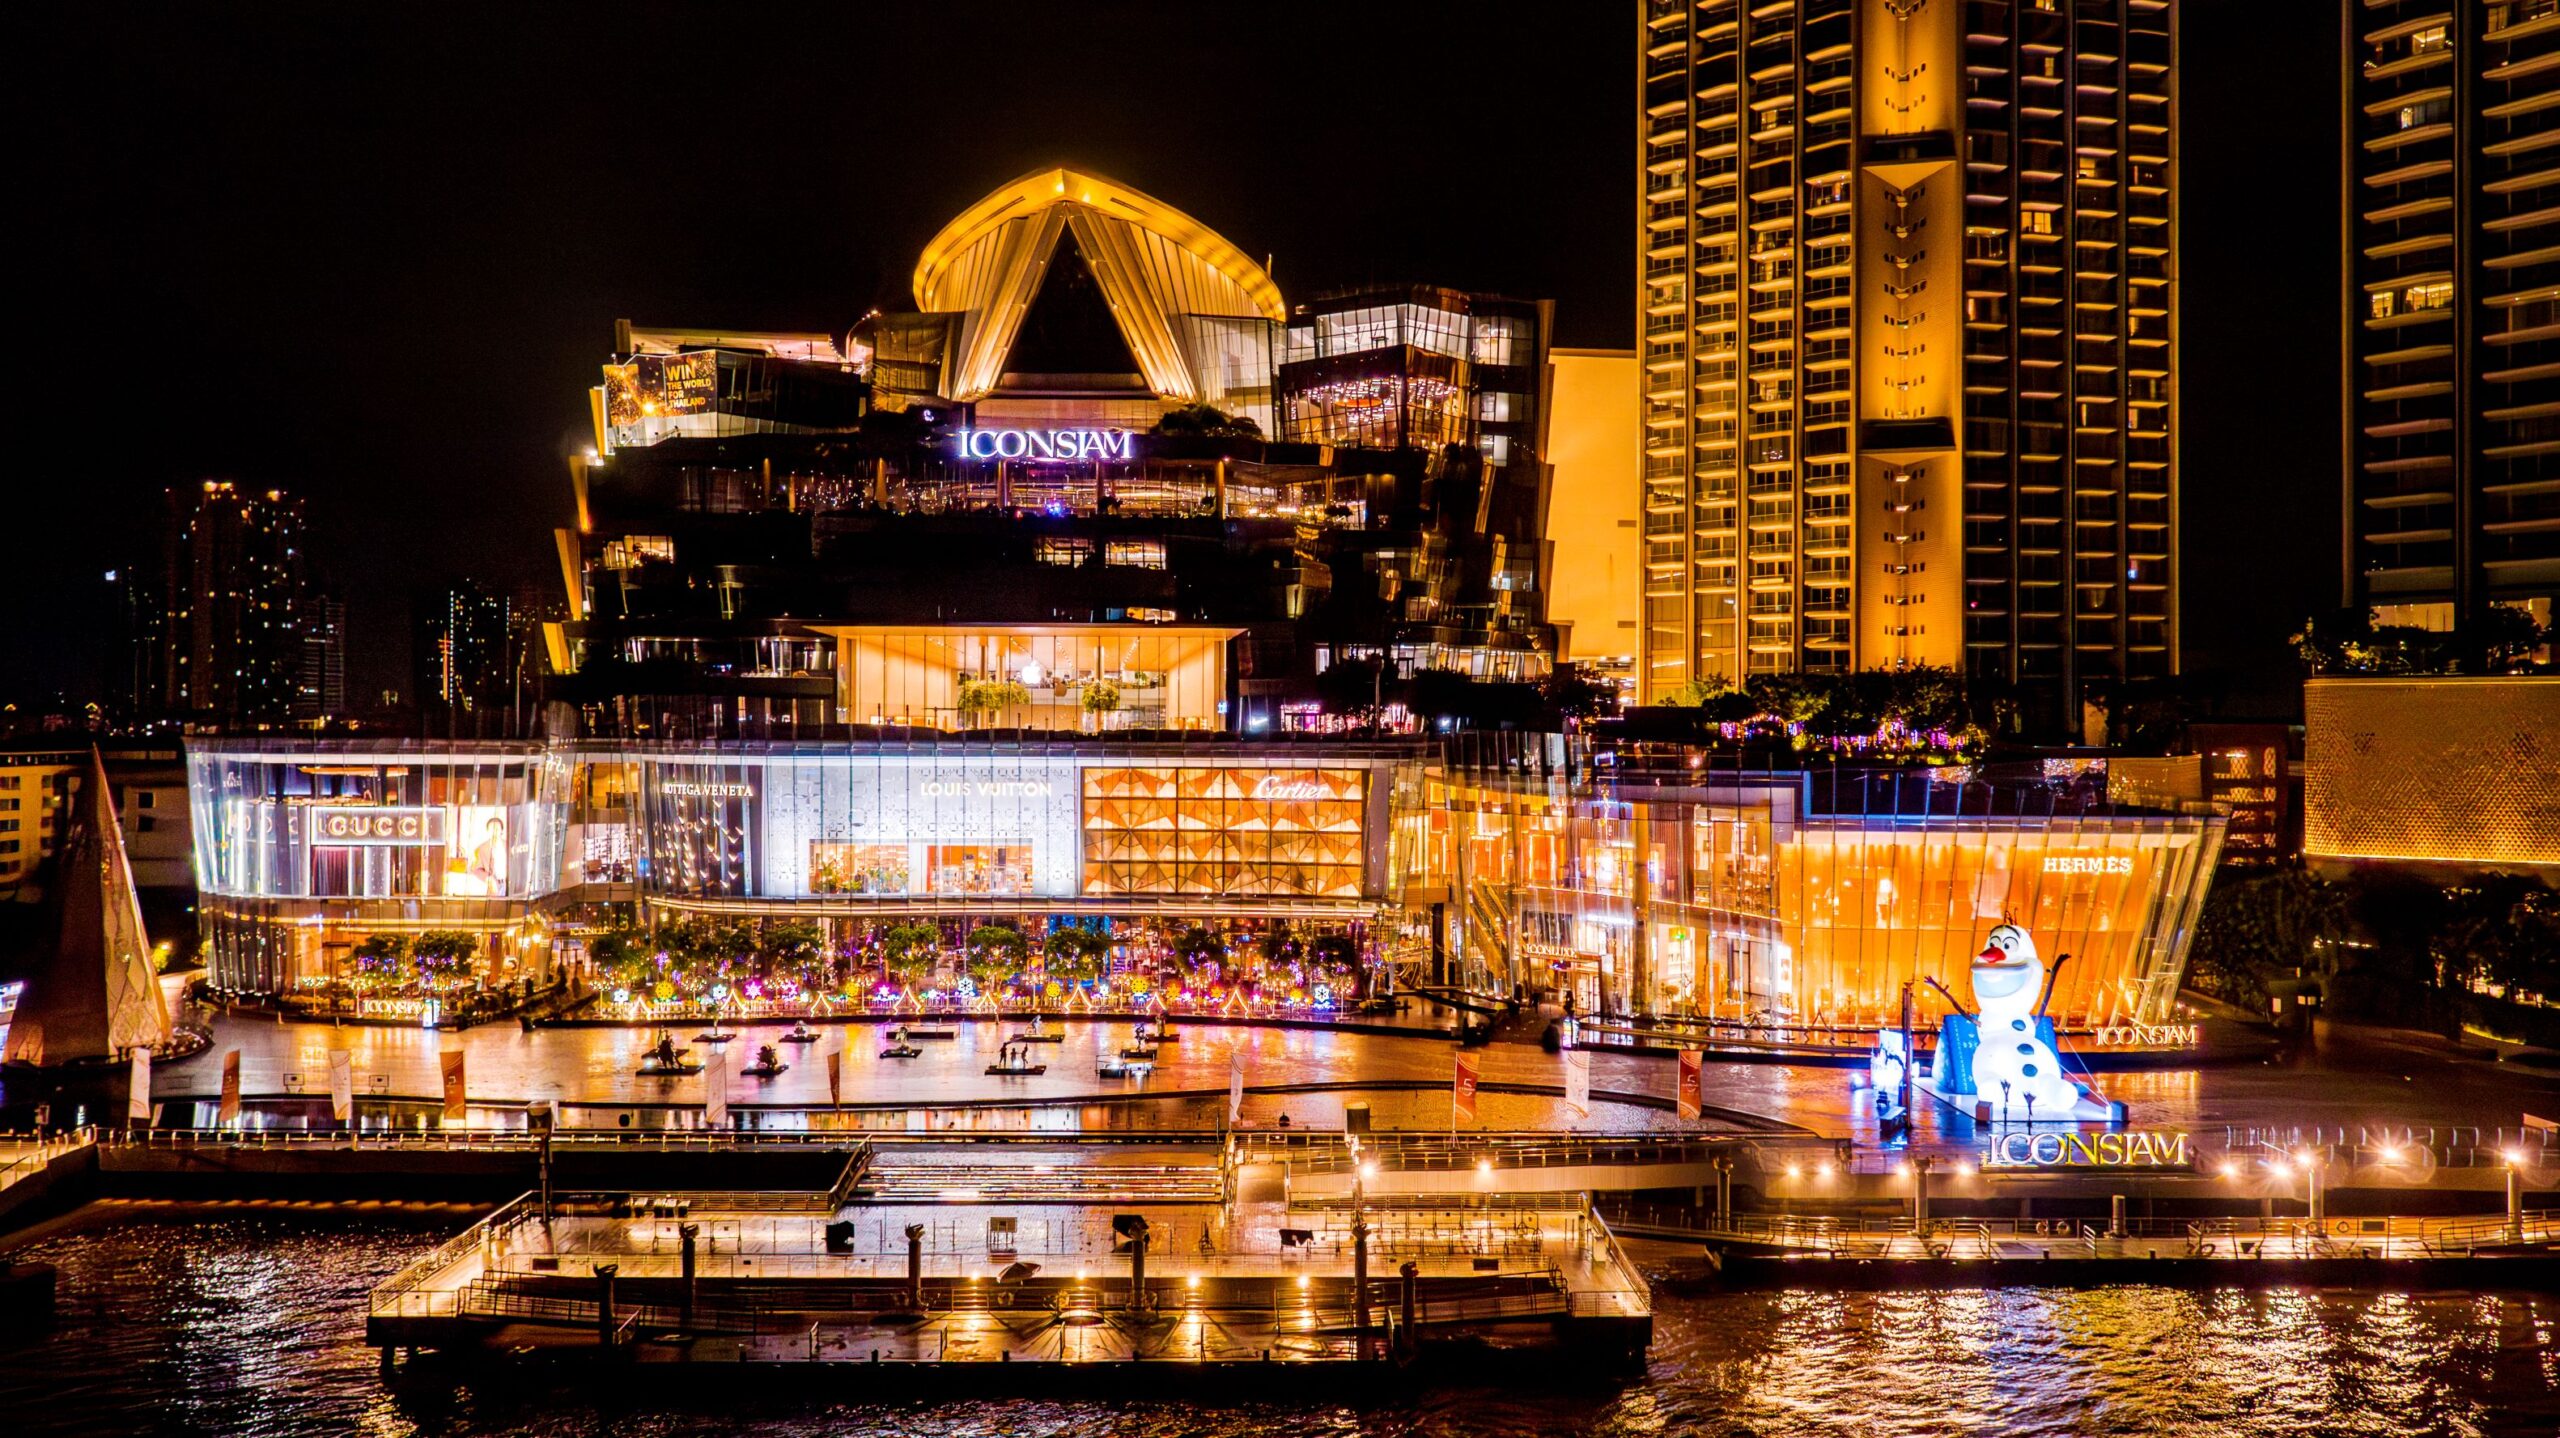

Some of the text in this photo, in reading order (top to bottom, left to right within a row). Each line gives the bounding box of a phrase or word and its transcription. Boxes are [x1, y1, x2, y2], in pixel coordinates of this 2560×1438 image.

[666, 364, 697, 381] WIN
[667, 378, 712, 390] THE WORLD
[668, 390, 684, 400] FOR
[669, 396, 706, 408] THAILAND
[958, 430, 1133, 459] ICONSIAM
[702, 784, 754, 797] VENETA
[920, 782, 1053, 796] LOUIS VUITTON
[1256, 776, 1330, 800] Cartier
[328, 815, 428, 836] GUCC
[2096, 1025, 2199, 1046] ICONSIAM
[1988, 1132, 2189, 1166] ICONSIAM
